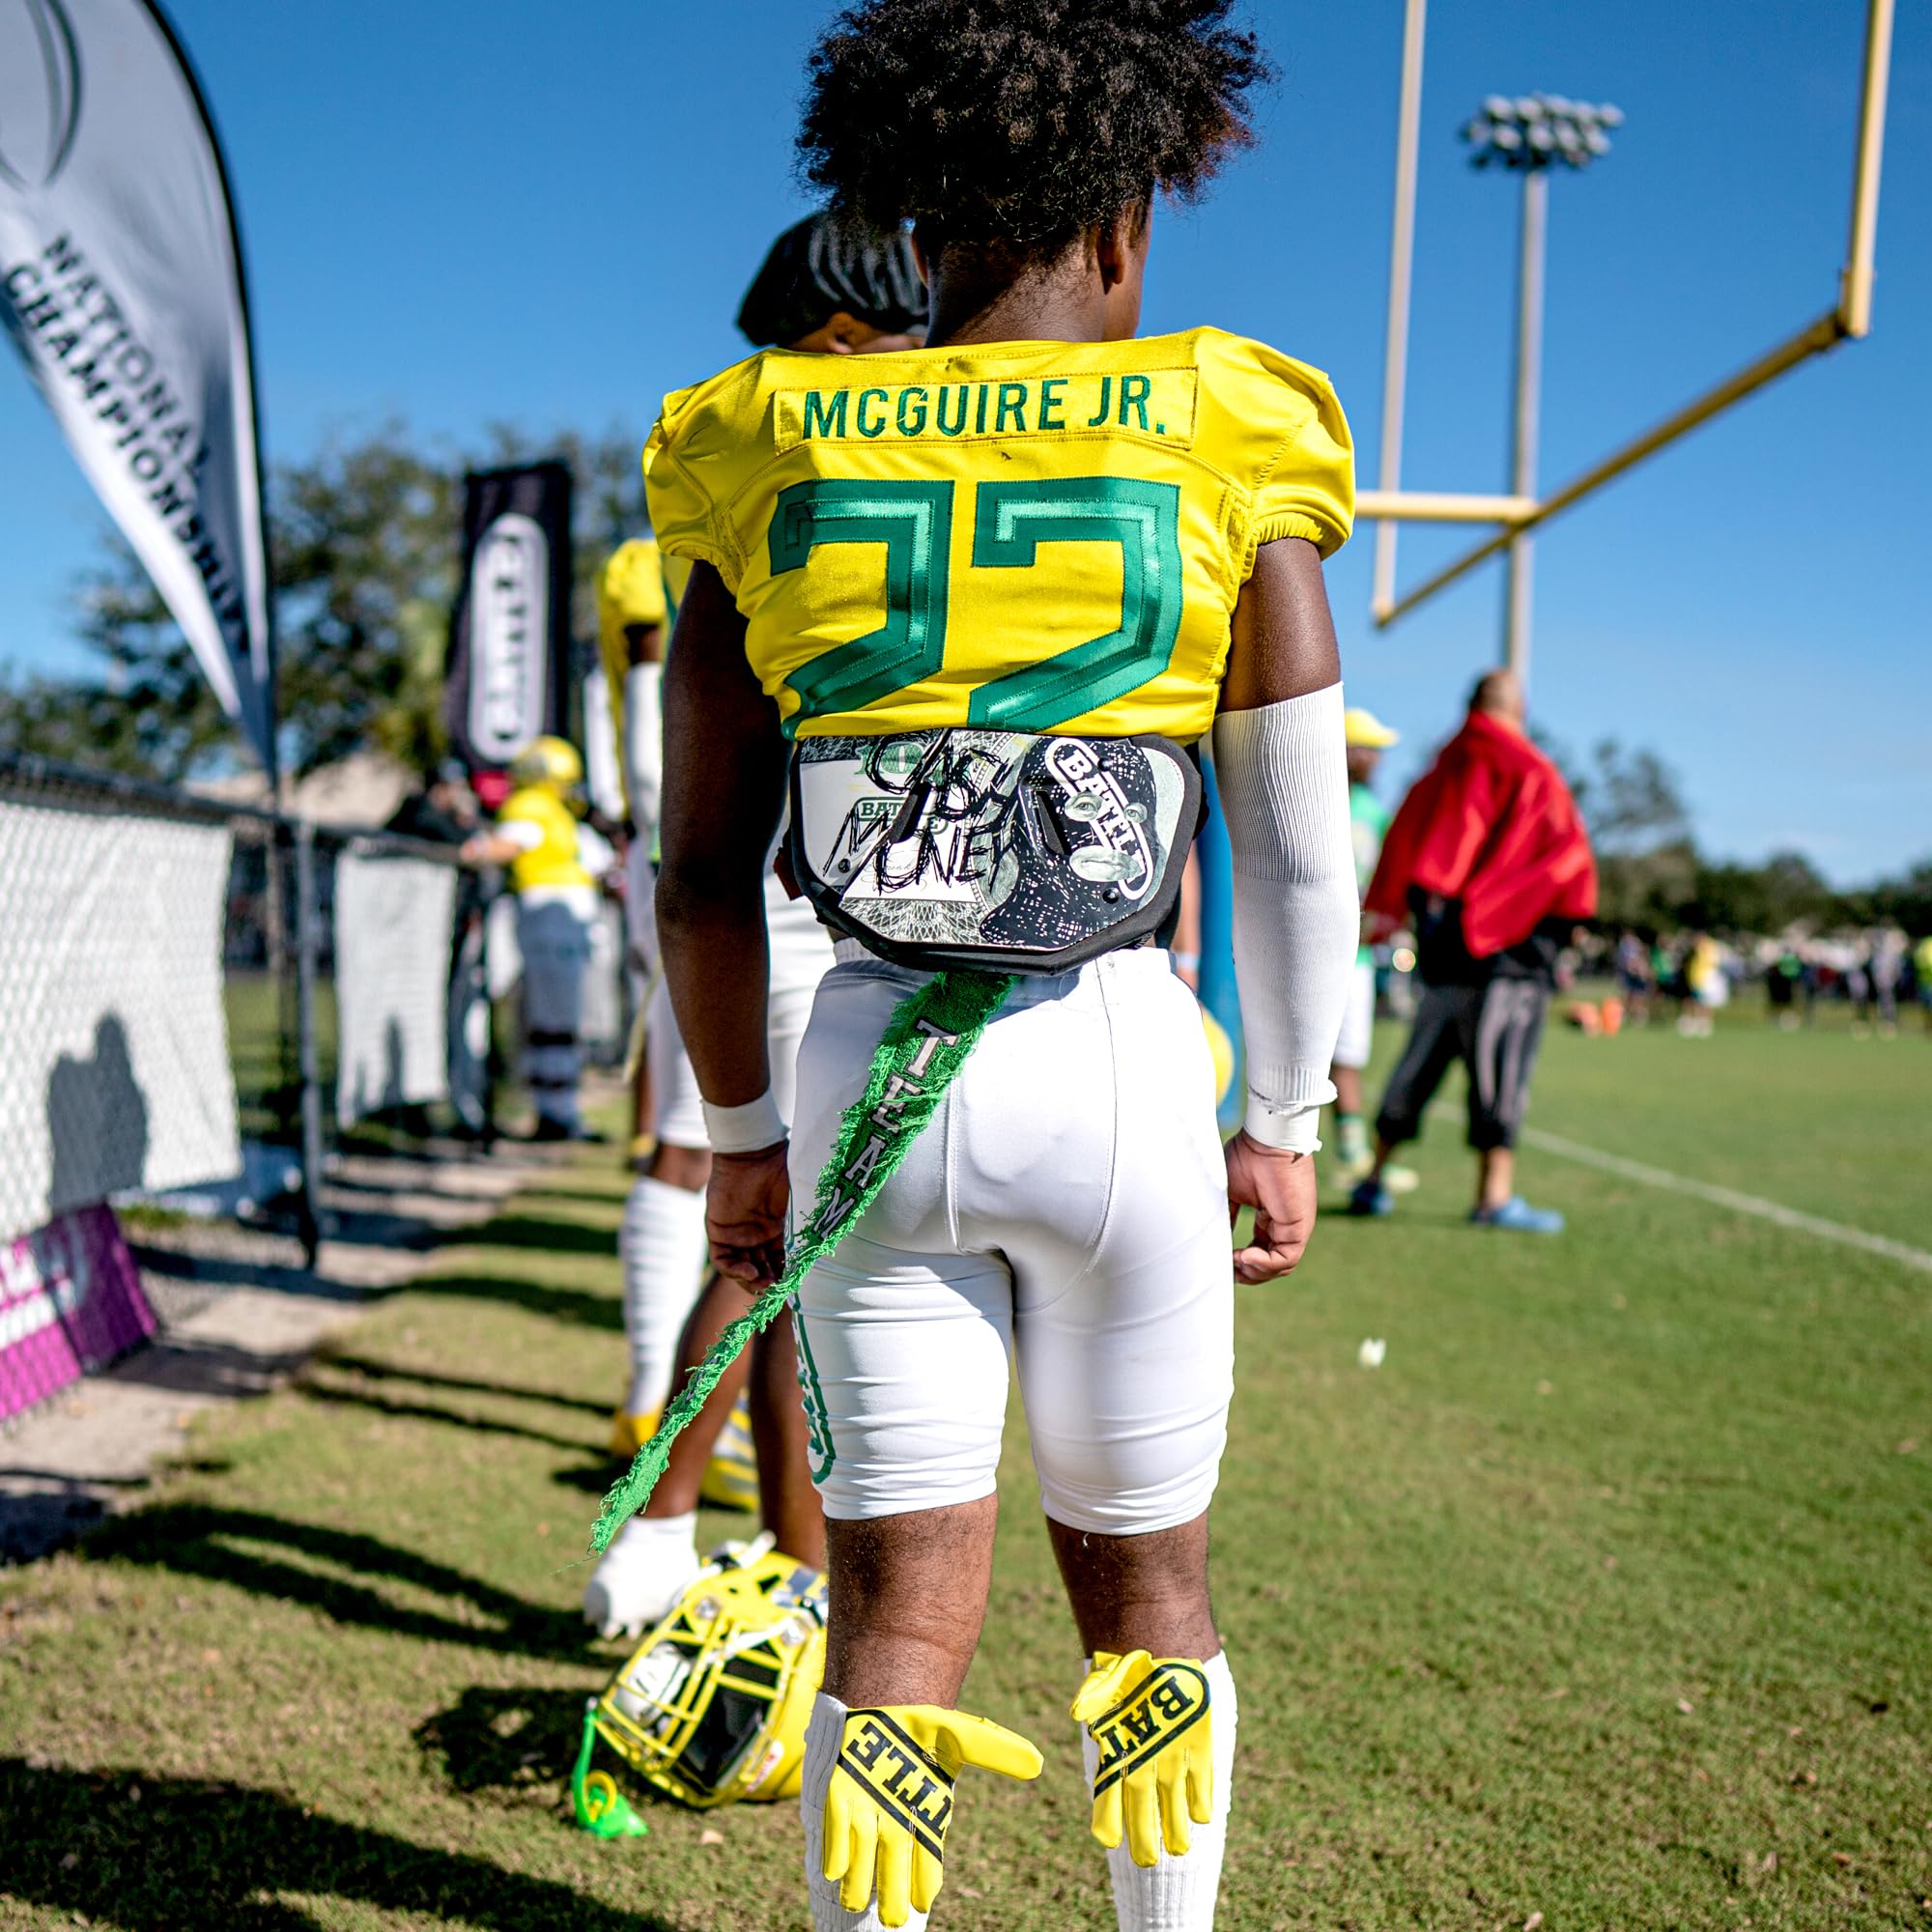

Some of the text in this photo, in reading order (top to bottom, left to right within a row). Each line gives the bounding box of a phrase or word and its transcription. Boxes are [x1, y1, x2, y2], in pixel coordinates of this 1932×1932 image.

[803, 374, 1166, 439] MCGUIRE JR.
[768, 476, 1182, 742] 22
[860, 802, 939, 832] BATE
